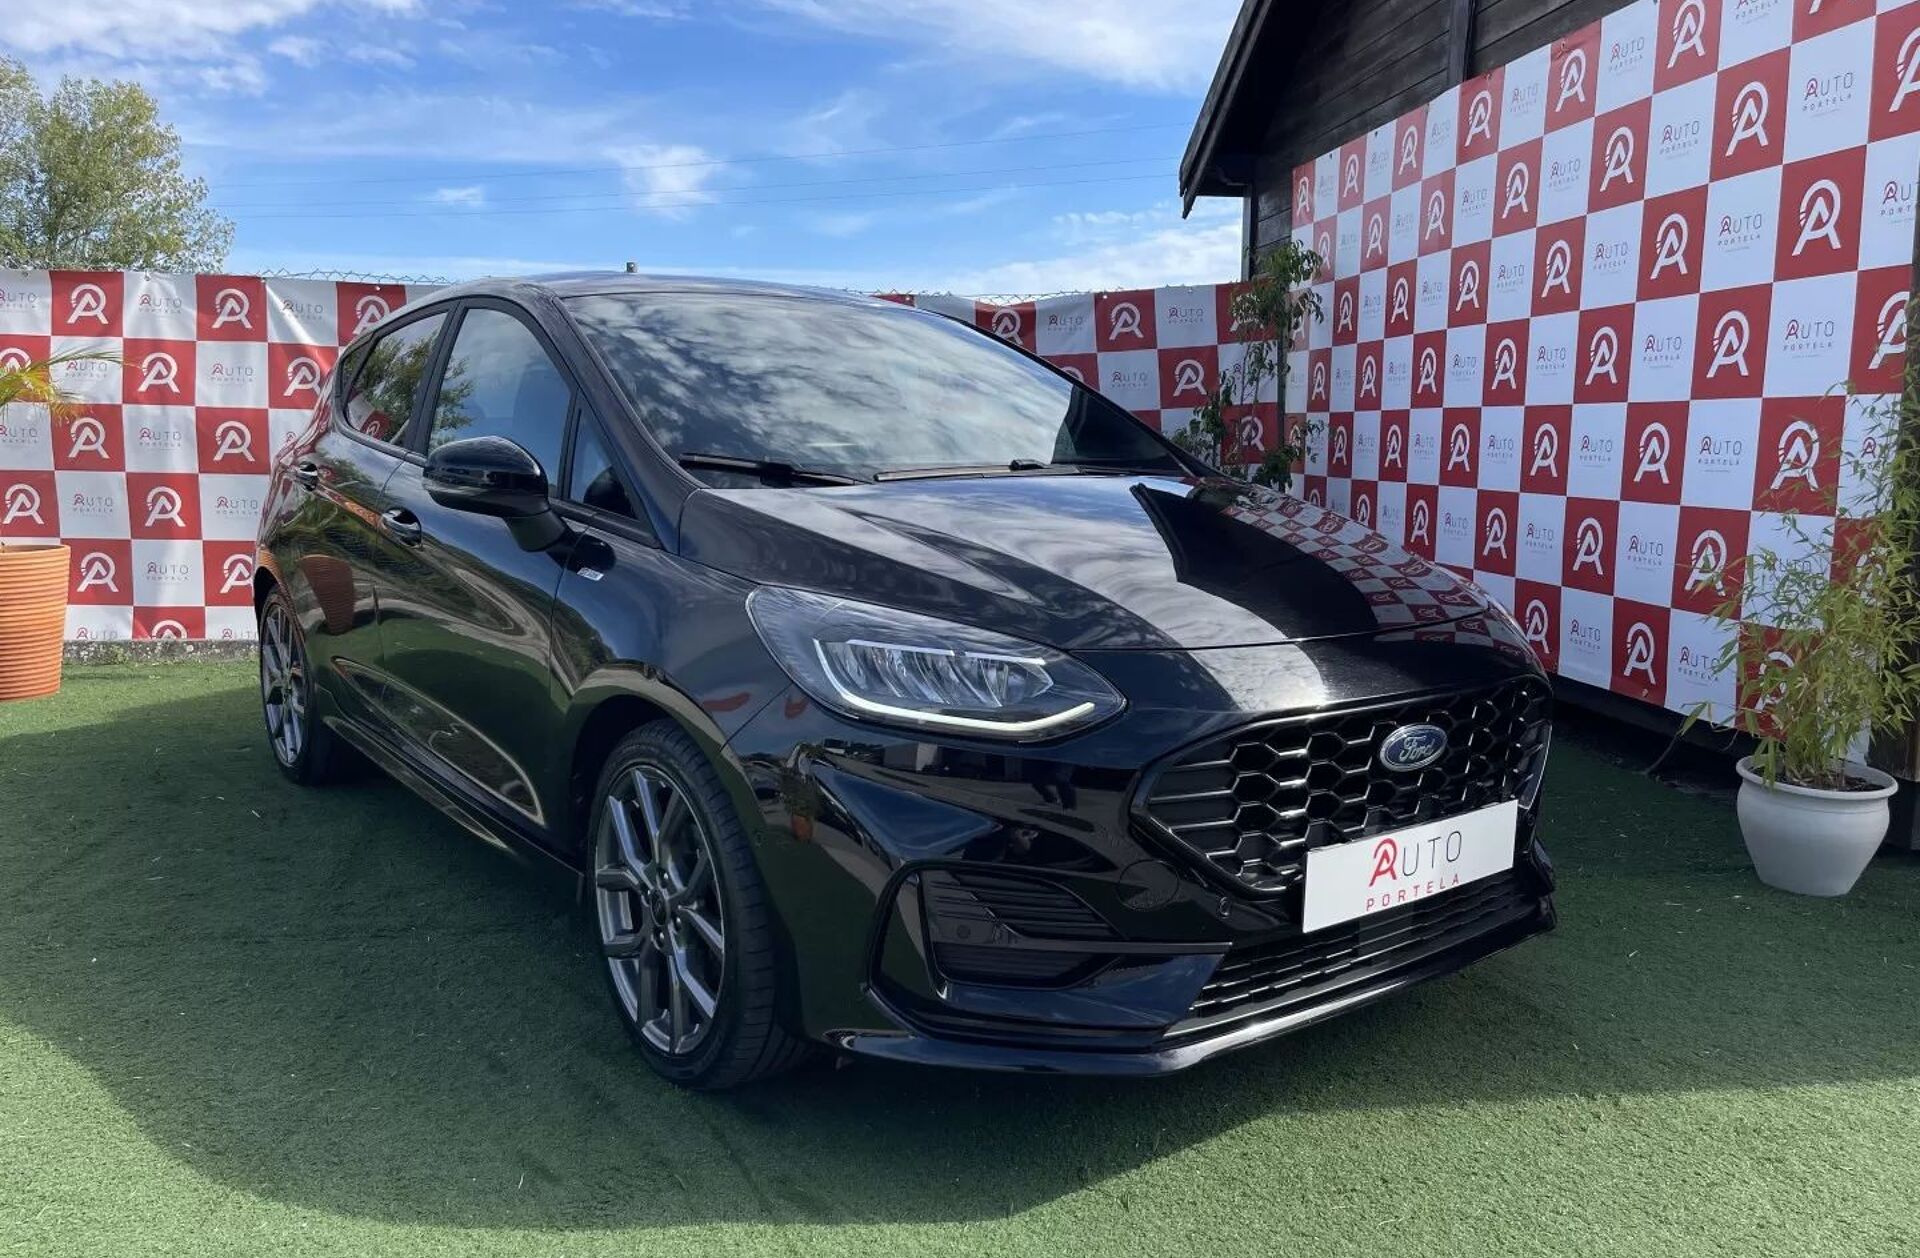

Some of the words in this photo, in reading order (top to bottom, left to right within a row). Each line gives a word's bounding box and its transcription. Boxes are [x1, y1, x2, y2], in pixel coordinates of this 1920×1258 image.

[1610, 35, 1643, 62] AUTO
[1804, 70, 1853, 100] AUTO
[1661, 120, 1698, 144] AUTO
[1550, 158, 1580, 179] AUTO
[1719, 213, 1762, 236] AUTO
[1594, 242, 1627, 260] AUTO
[1785, 319, 1834, 340] AUTO
[1537, 345, 1565, 362] AUTO
[1644, 334, 1681, 352] AUTO
[1580, 434, 1611, 452] AUTO
[1699, 435, 1741, 456] AUTO
[1526, 522, 1552, 541] AUTO
[1628, 535, 1663, 557] AUTO
[1570, 618, 1600, 642] AUTO
[1399, 734, 1437, 761] Ford
[1369, 831, 1462, 887] AUTO
[1366, 874, 1460, 911] PORTELA
